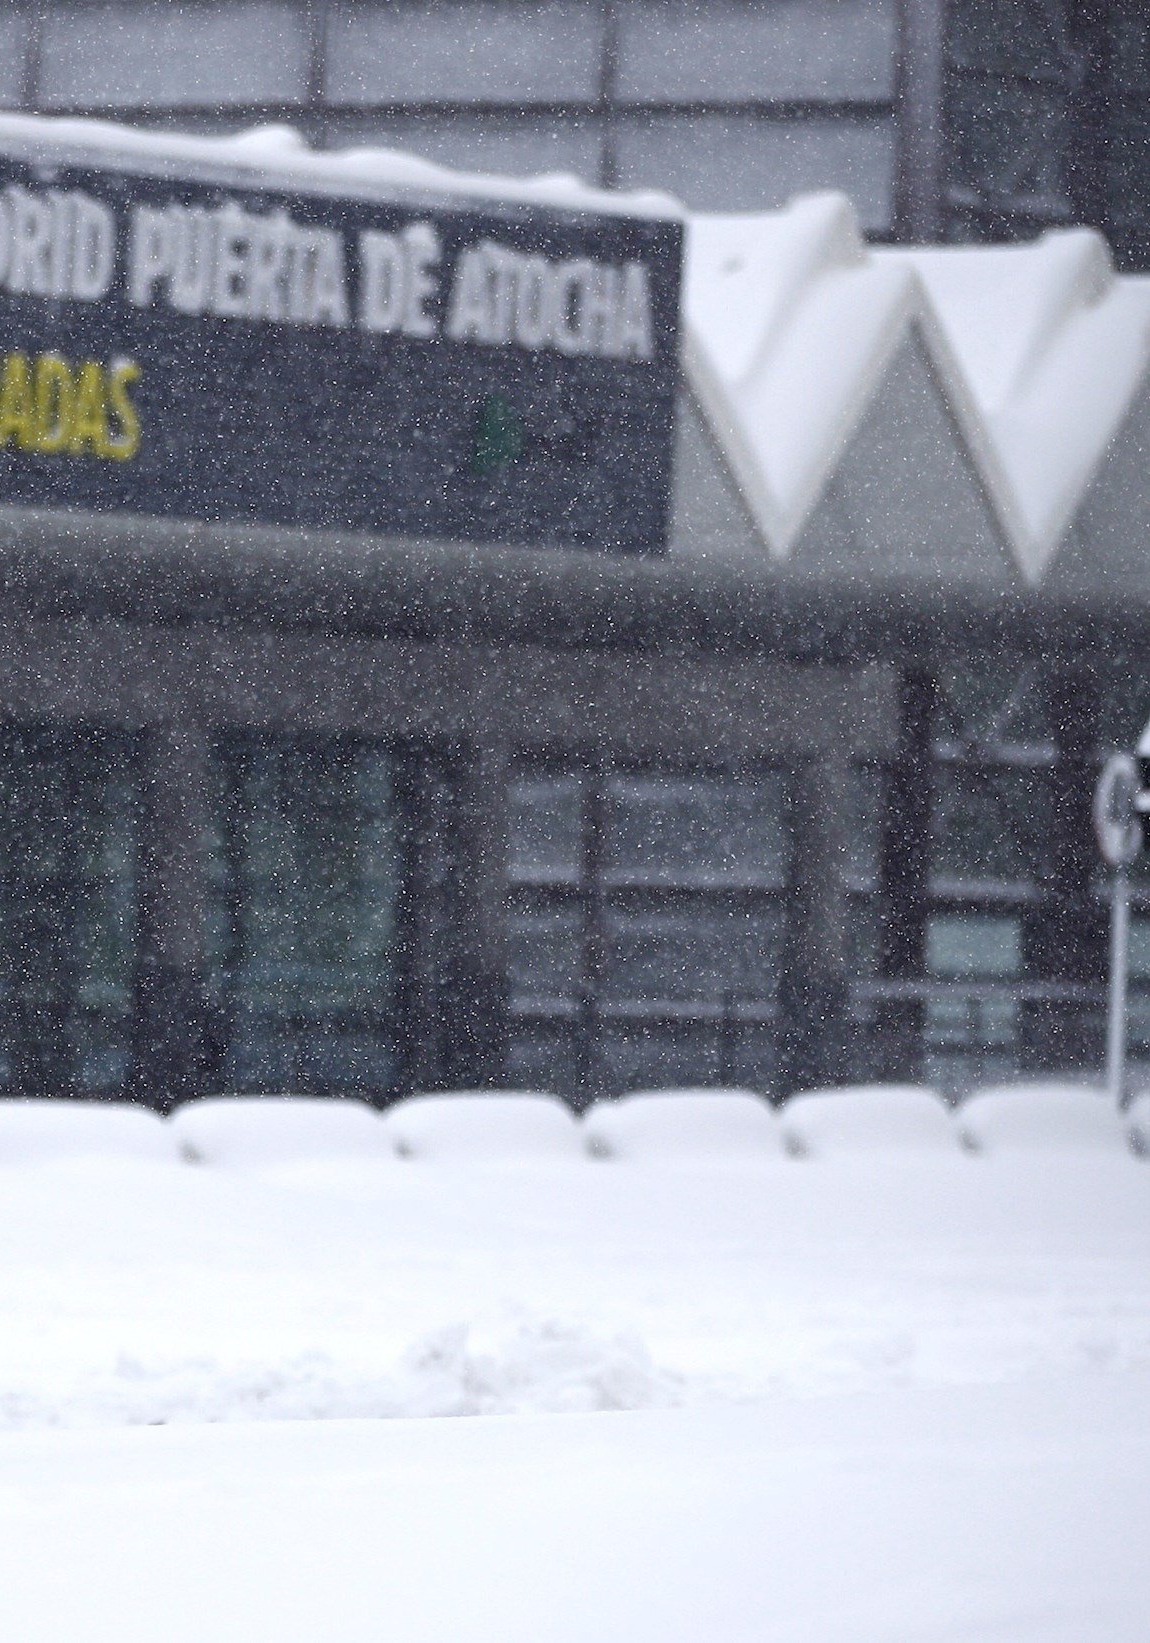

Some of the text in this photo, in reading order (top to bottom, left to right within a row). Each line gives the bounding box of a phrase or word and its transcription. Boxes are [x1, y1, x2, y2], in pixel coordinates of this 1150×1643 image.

[129, 205, 350, 330] PUERTA
[358, 226, 441, 340] DE
[445, 242, 653, 361] ATOCHA
